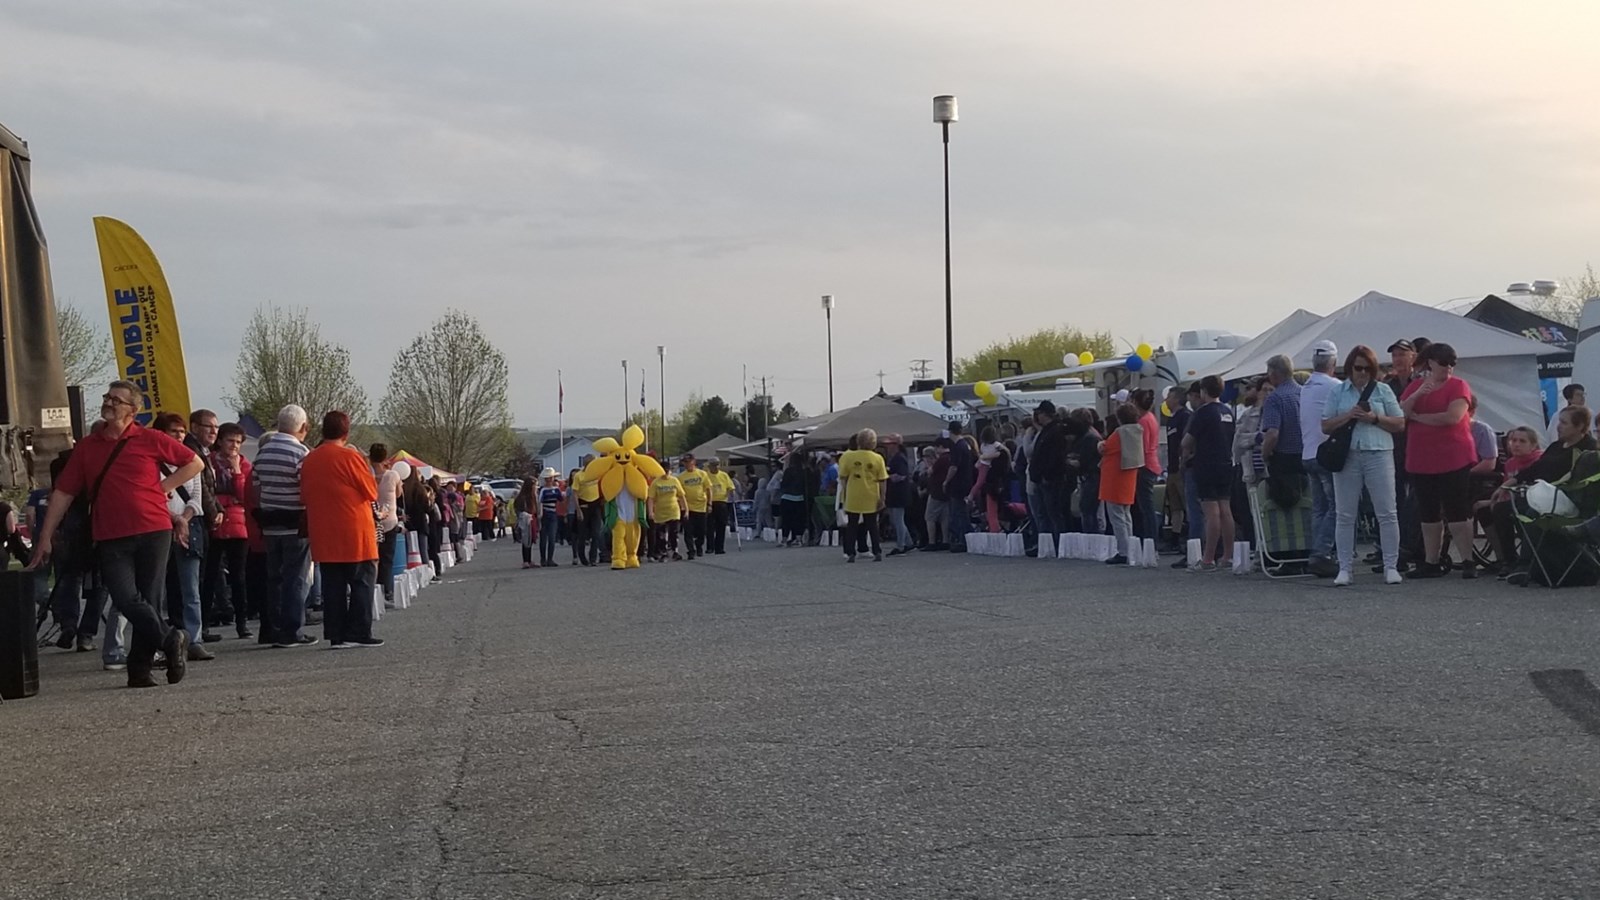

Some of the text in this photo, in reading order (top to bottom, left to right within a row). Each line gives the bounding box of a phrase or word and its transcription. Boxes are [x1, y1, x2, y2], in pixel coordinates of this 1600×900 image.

[138, 286, 148, 303] QUE
[147, 345, 156, 367] PLUS
[150, 370, 161, 408] SOMMES
